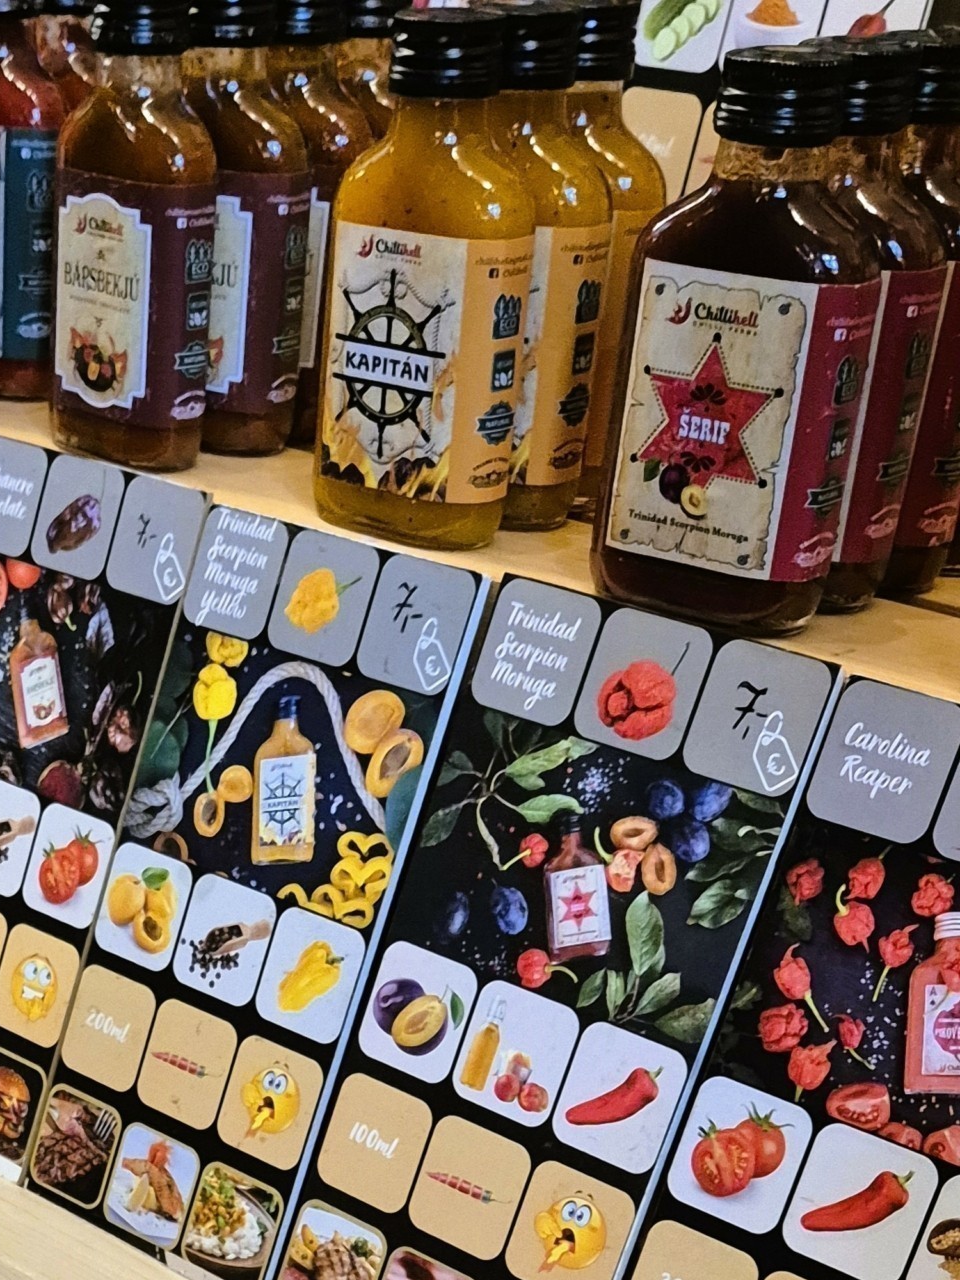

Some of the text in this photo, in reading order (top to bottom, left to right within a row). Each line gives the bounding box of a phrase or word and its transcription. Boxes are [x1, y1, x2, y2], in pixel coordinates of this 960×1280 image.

[375, 238, 422, 258] Chillihell
[63, 260, 139, 301] BÁRSBEKJÚ
[500, 316, 517, 330] ECO
[694, 301, 759, 329] Chillihell
[344, 354, 429, 383] KAPITÁN
[678, 407, 731, 445] ŠERIF
[216, 506, 276, 543] Trinidad
[628, 508, 749, 544] Trinidad Scorpion Moruga
[206, 535, 269, 573] Scorpion
[203, 561, 259, 597] Moruga
[194, 588, 247, 627] Yellow
[508, 600, 583, 644] Trinidad
[494, 631, 568, 673] Scorpion
[490, 659, 556, 711] Moruga
[843, 722, 931, 768] Carolina
[840, 754, 913, 800] Reaper
[84, 1008, 132, 1044] 200ml
[347, 1120, 401, 1160] 100ml
